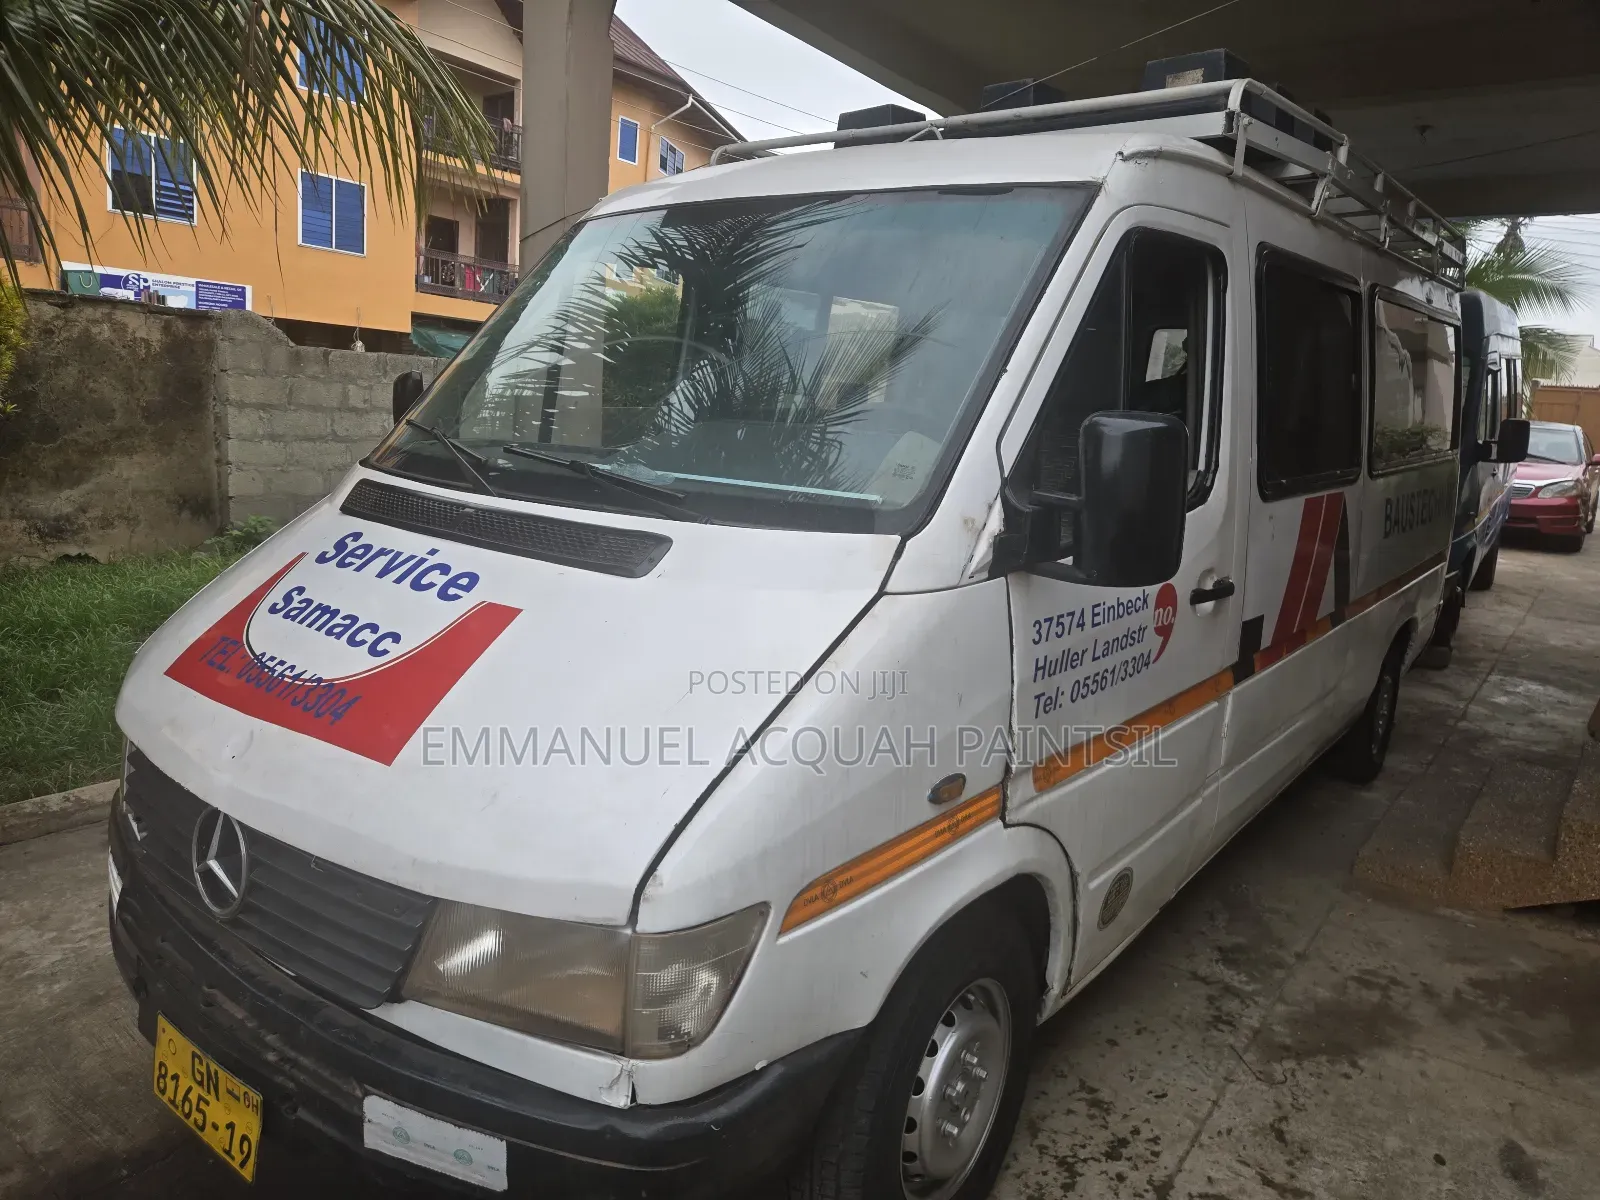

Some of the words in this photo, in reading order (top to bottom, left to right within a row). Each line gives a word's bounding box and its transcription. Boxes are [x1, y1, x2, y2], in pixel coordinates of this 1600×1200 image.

[314, 531, 481, 602] Service
[267, 586, 402, 658] Samacc
[1032, 607, 1086, 645] 37574
[1091, 589, 1150, 628] Einbeck
[237, 651, 362, 726] 05561/3304
[1033, 647, 1089, 683] Huller
[1092, 625, 1148, 662] Landstr
[1033, 689, 1065, 719] Tel:
[1070, 649, 1152, 703] 05561/3304
[156, 1061, 253, 1169] 8165-19
[191, 1050, 220, 1102] GN
[243, 1091, 259, 1116] GH
